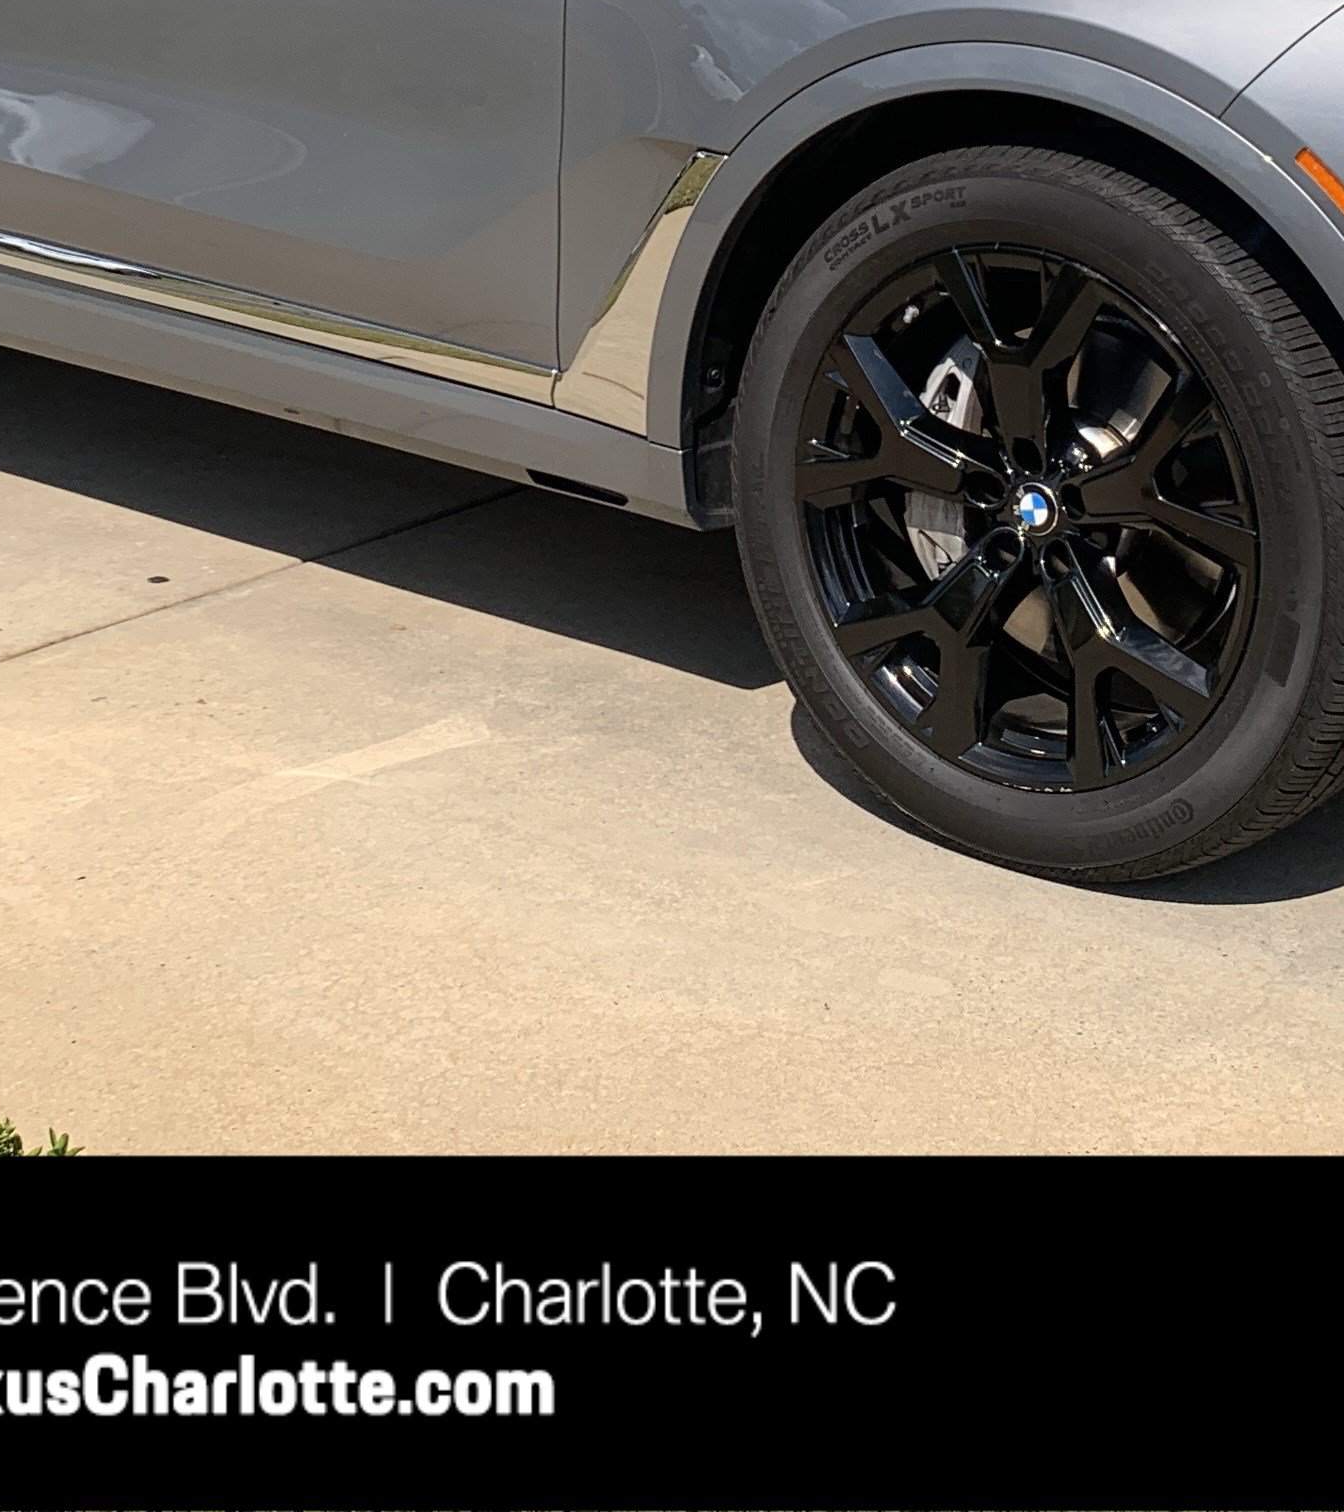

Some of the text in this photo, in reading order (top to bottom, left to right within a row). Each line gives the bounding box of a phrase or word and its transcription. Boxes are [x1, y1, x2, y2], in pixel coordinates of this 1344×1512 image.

[824, 187, 967, 263] CROSS LX SPORT
